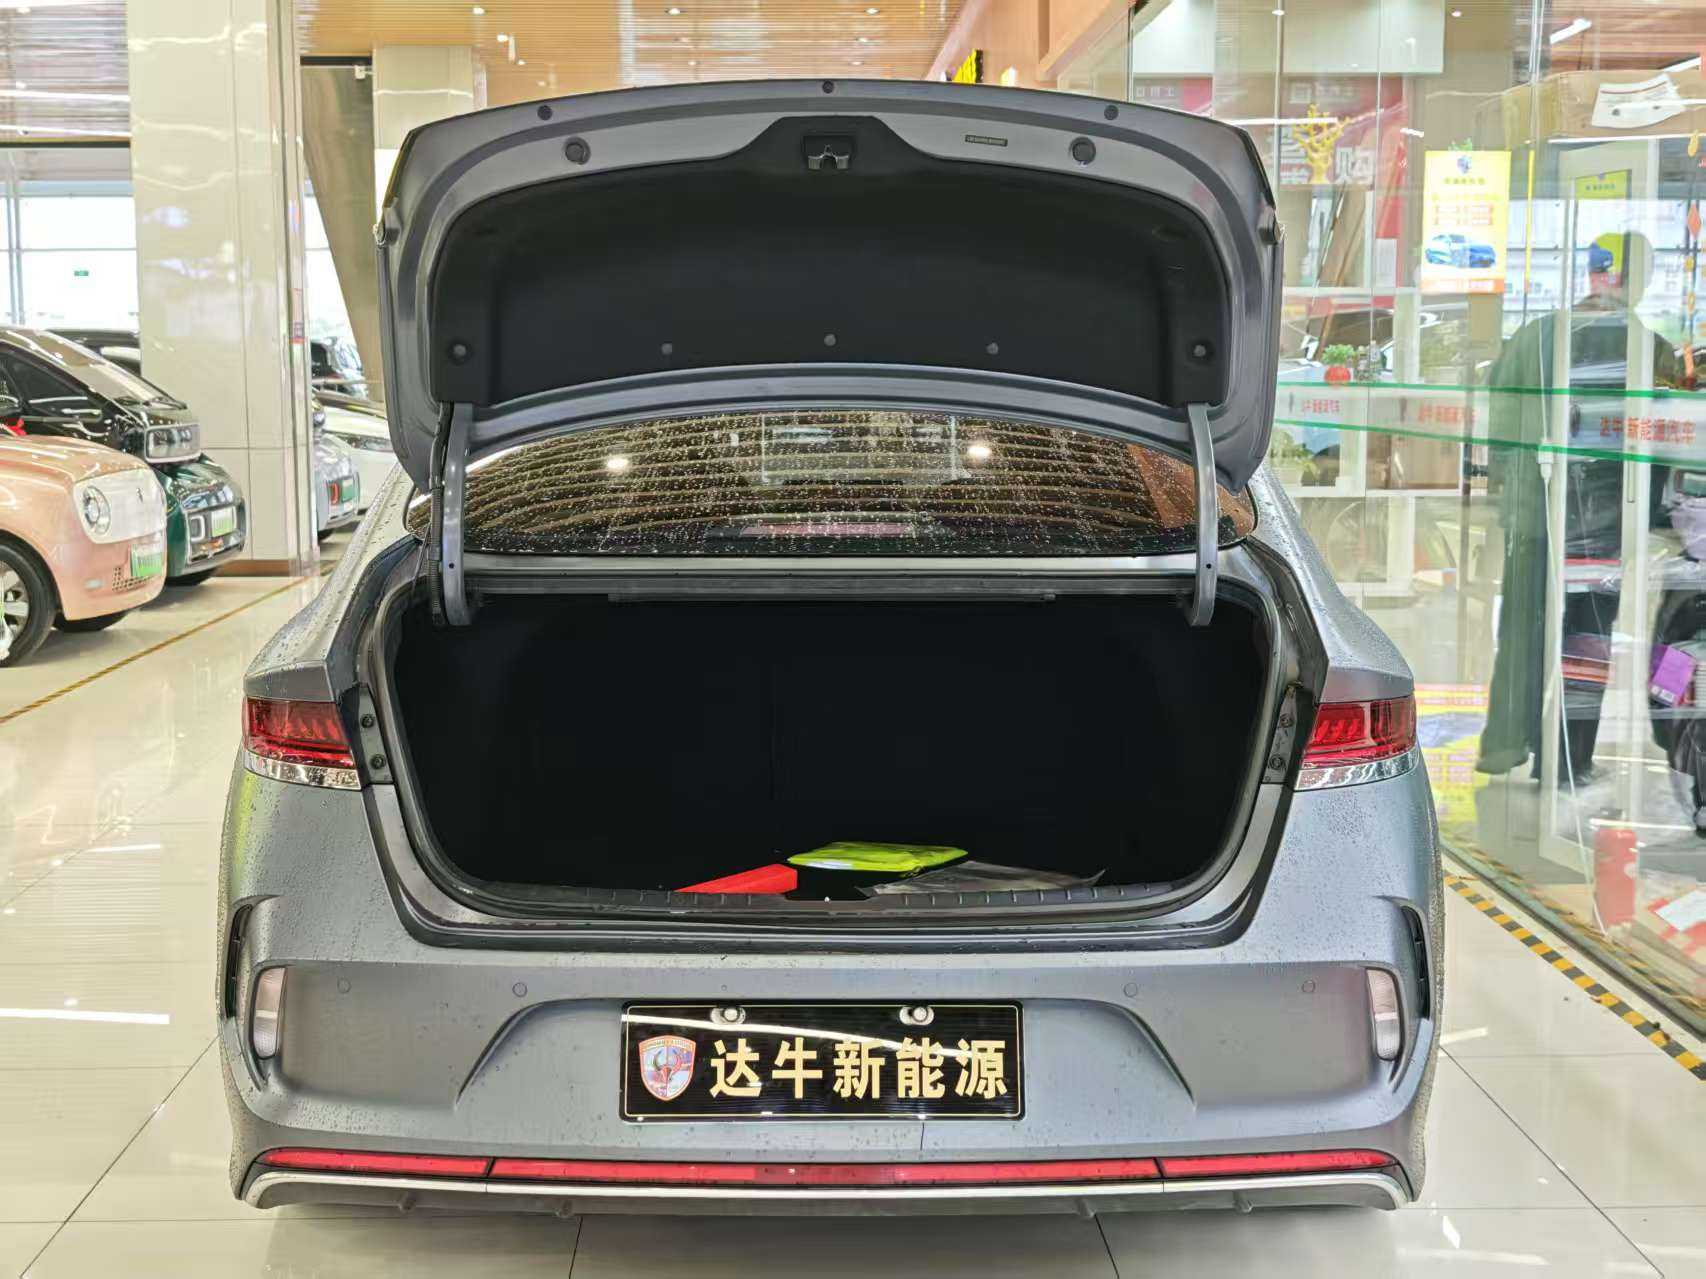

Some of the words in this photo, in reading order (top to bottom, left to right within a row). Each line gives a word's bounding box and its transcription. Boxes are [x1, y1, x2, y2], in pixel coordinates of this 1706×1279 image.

[709, 1037, 1008, 1100] 达牛新能源
